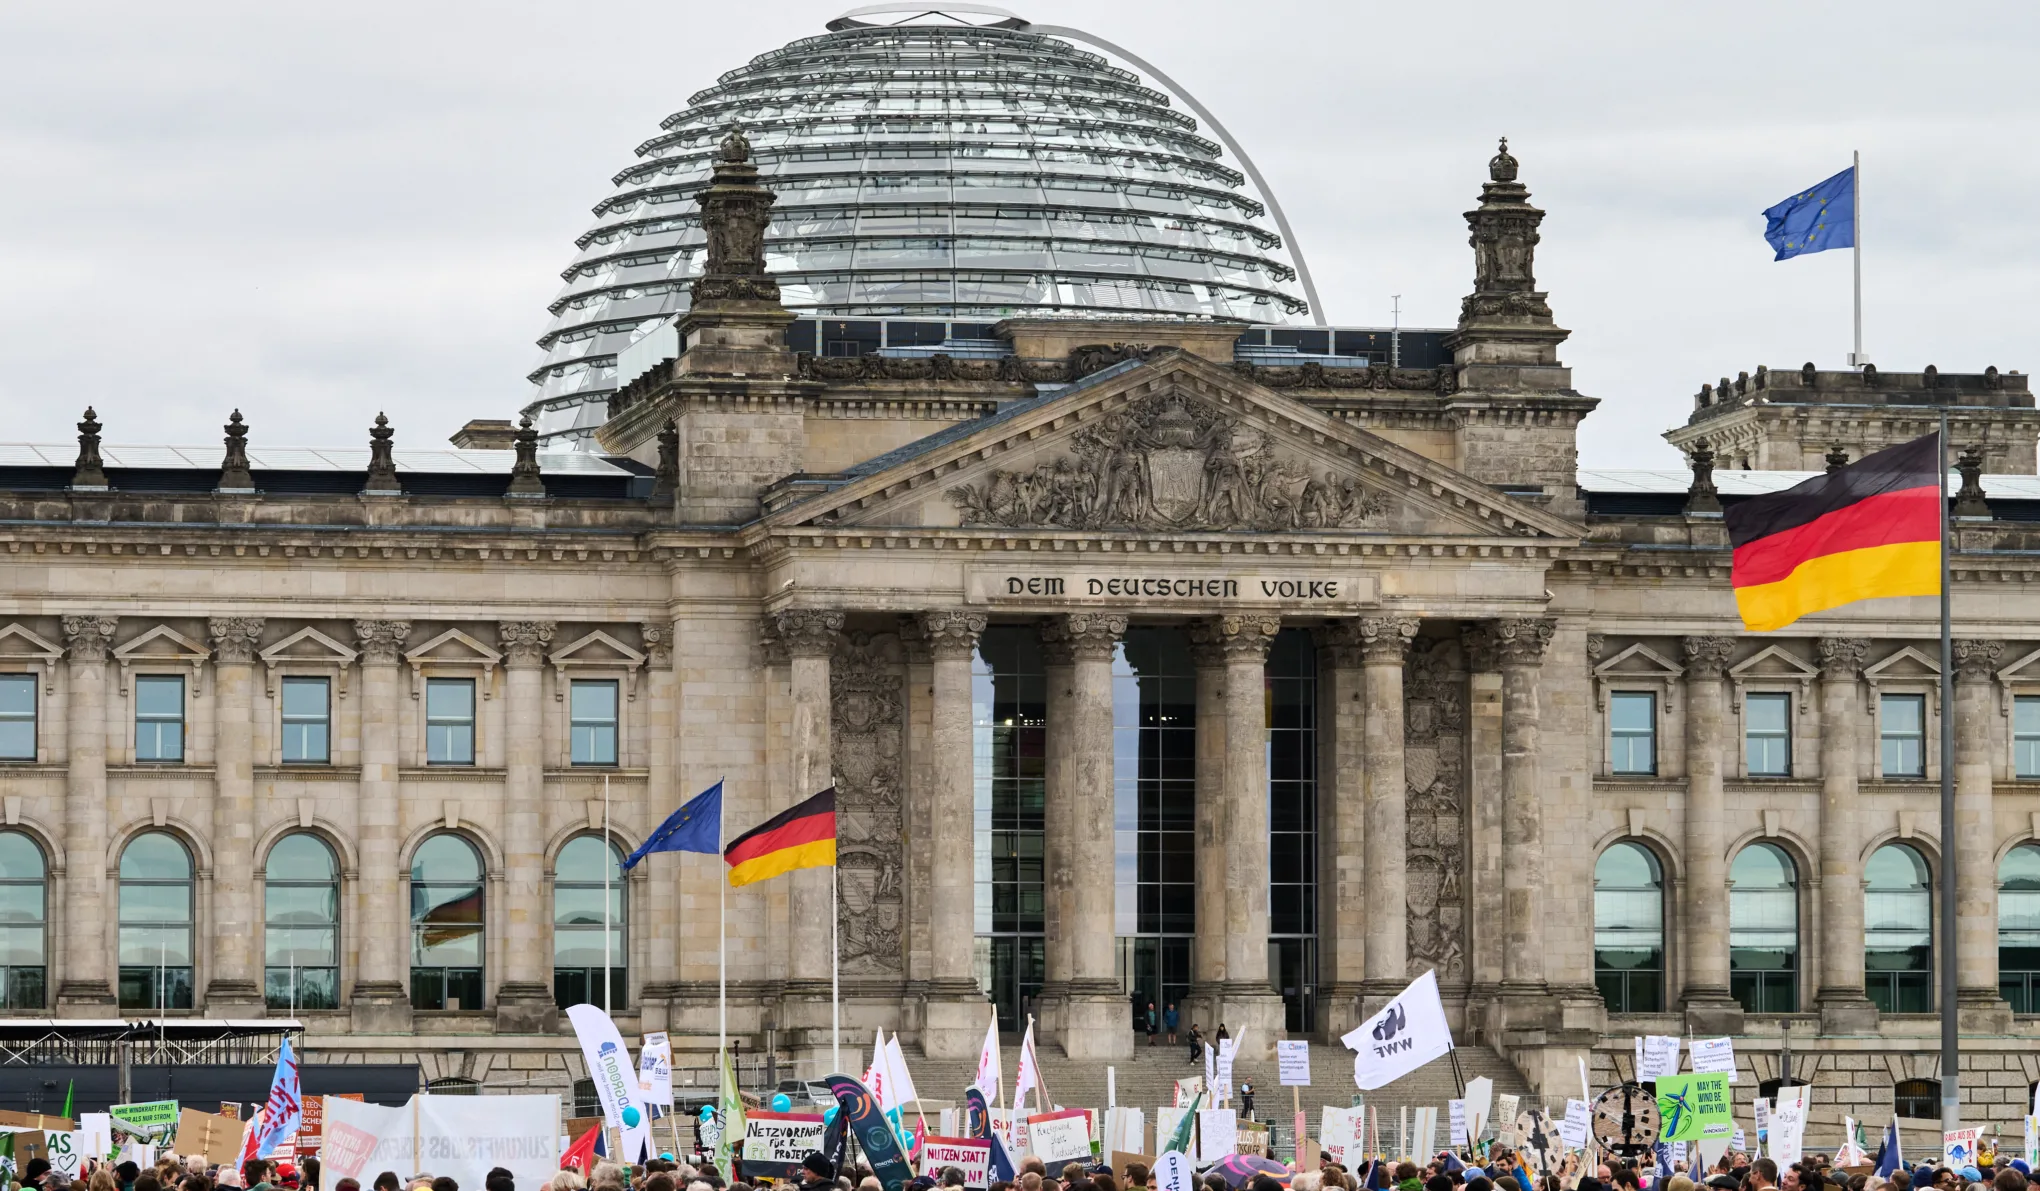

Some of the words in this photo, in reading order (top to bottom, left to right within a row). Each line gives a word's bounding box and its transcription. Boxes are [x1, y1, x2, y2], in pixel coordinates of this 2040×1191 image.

[1007, 577, 1065, 595] DEM
[1087, 578, 1239, 597] DEUTSCHEN
[1261, 580, 1339, 598] VOLKE
[1697, 1081, 1709, 1091] MAY
[1711, 1080, 1722, 1090] THE
[1697, 1093, 1713, 1103] WIND
[1714, 1092, 1722, 1102] BE
[1699, 1104, 1714, 1114] WITH
[1715, 1103, 1726, 1113] YOU
[747, 1121, 823, 1138] NETZVORFAHRT
[1945, 1132, 1956, 1142] RAUS
[1957, 1131, 1966, 1140] AUS
[1966, 1129, 1976, 1139] DEN
[769, 1138, 785, 1148] FÜR
[775, 1149, 820, 1160] PROJEKT
[1328, 1144, 1344, 1155] HAVE
[927, 1148, 960, 1161] NUTZEN
[961, 1150, 986, 1163] STATT
